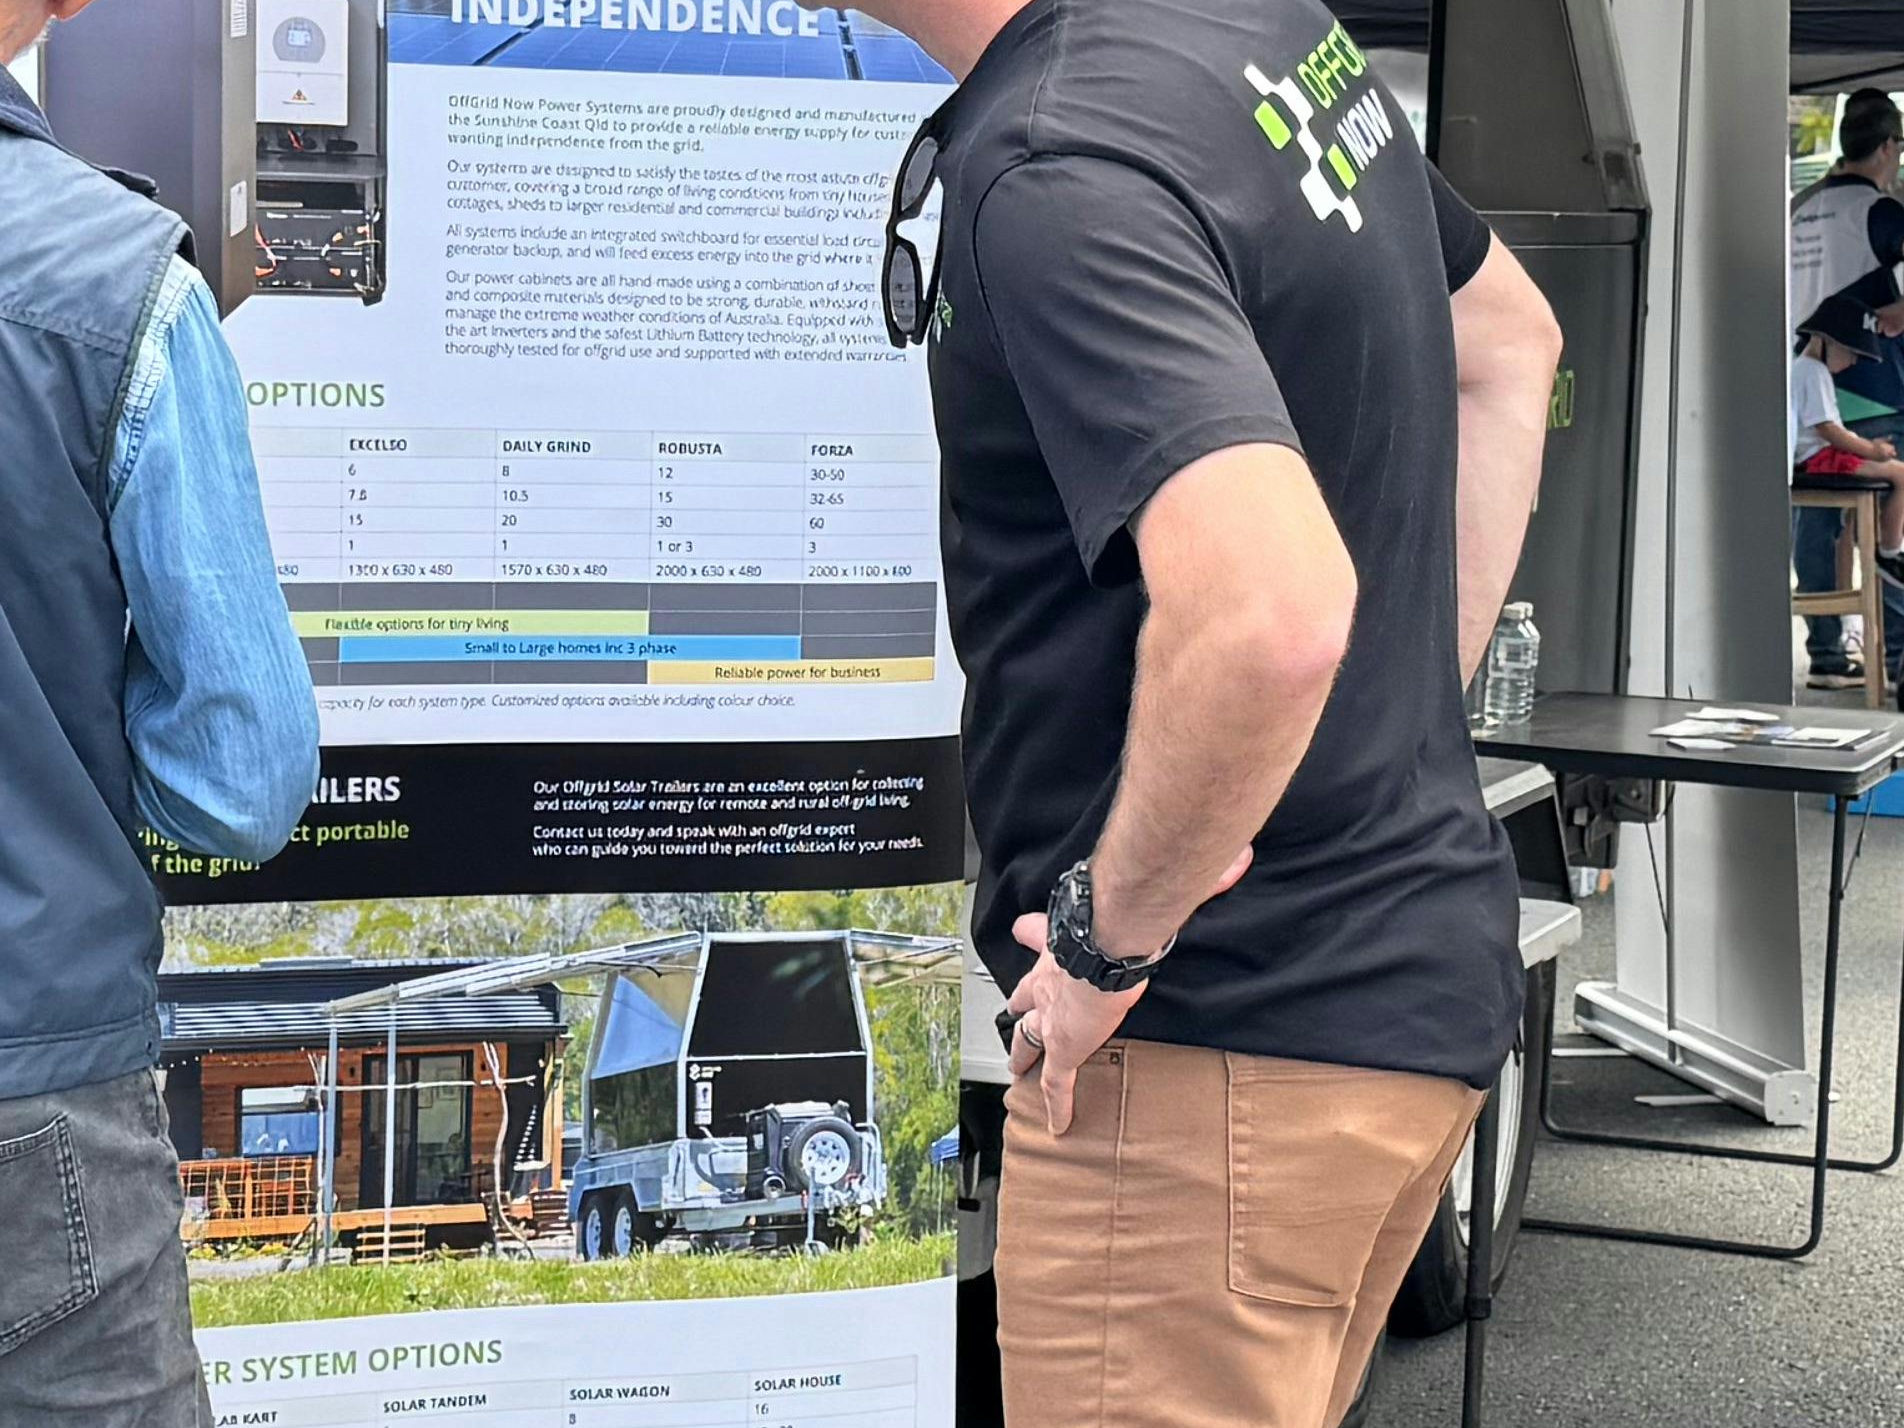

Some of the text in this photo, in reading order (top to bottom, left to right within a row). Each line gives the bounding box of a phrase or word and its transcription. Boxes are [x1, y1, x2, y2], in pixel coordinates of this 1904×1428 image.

[1336, 88, 1394, 171] NOW
[445, 243, 508, 259] generator
[566, 244, 591, 258] and
[594, 245, 615, 258] will
[619, 246, 647, 260] feed
[650, 249, 694, 261] excess
[697, 250, 741, 265] energy
[744, 249, 769, 263] into
[772, 249, 793, 263] the
[796, 250, 821, 267] grid
[444, 307, 496, 322] manage
[499, 308, 521, 320] the
[524, 309, 579, 321] extreme
[582, 309, 634, 322] weather
[638, 310, 705, 324] conditions
[708, 311, 722, 324] of
[246, 382, 385, 407] OPTIONS
[503, 440, 590, 452] DAILY GRIND
[658, 442, 722, 454] ROBUSTA
[811, 444, 853, 456] FORZA
[658, 466, 673, 478] 12
[810, 468, 845, 481] 30-50
[658, 491, 673, 503] 15
[501, 514, 517, 526] 20
[656, 516, 672, 527] 30
[808, 517, 824, 529] 60
[658, 540, 692, 552] 1 or 3
[808, 541, 816, 553] 3
[502, 563, 532, 575] 1570
[536, 566, 541, 575] x
[546, 563, 569, 575] 630
[573, 566, 579, 575] x
[656, 564, 687, 576] 2000
[376, 618, 423, 632] options
[427, 616, 445, 629] for
[449, 617, 472, 632] tiny
[476, 617, 508, 632] living
[464, 641, 499, 653] Small
[501, 642, 516, 653] to
[518, 641, 554, 657] Large
[557, 640, 601, 654] homes
[626, 642, 635, 654] 3
[638, 640, 677, 657] phase
[714, 665, 881, 681] Reliable power for business
[316, 820, 410, 846] portable
[533, 825, 584, 838] Contact
[587, 827, 603, 837] us
[606, 825, 645, 841] today
[646, 825, 673, 837] and
[675, 824, 716, 840] speak
[749, 826, 767, 836] an
[769, 823, 812, 839] offgrid
[165, 854, 203, 874] the
[241, 1350, 357, 1383] SYSTEM
[367, 1338, 502, 1372] OPTIONS
[753, 1374, 842, 1391] SOLAR HOUSE
[569, 1387, 613, 1400] SOLAR
[383, 1393, 487, 1413] SOLAR TANDEM
